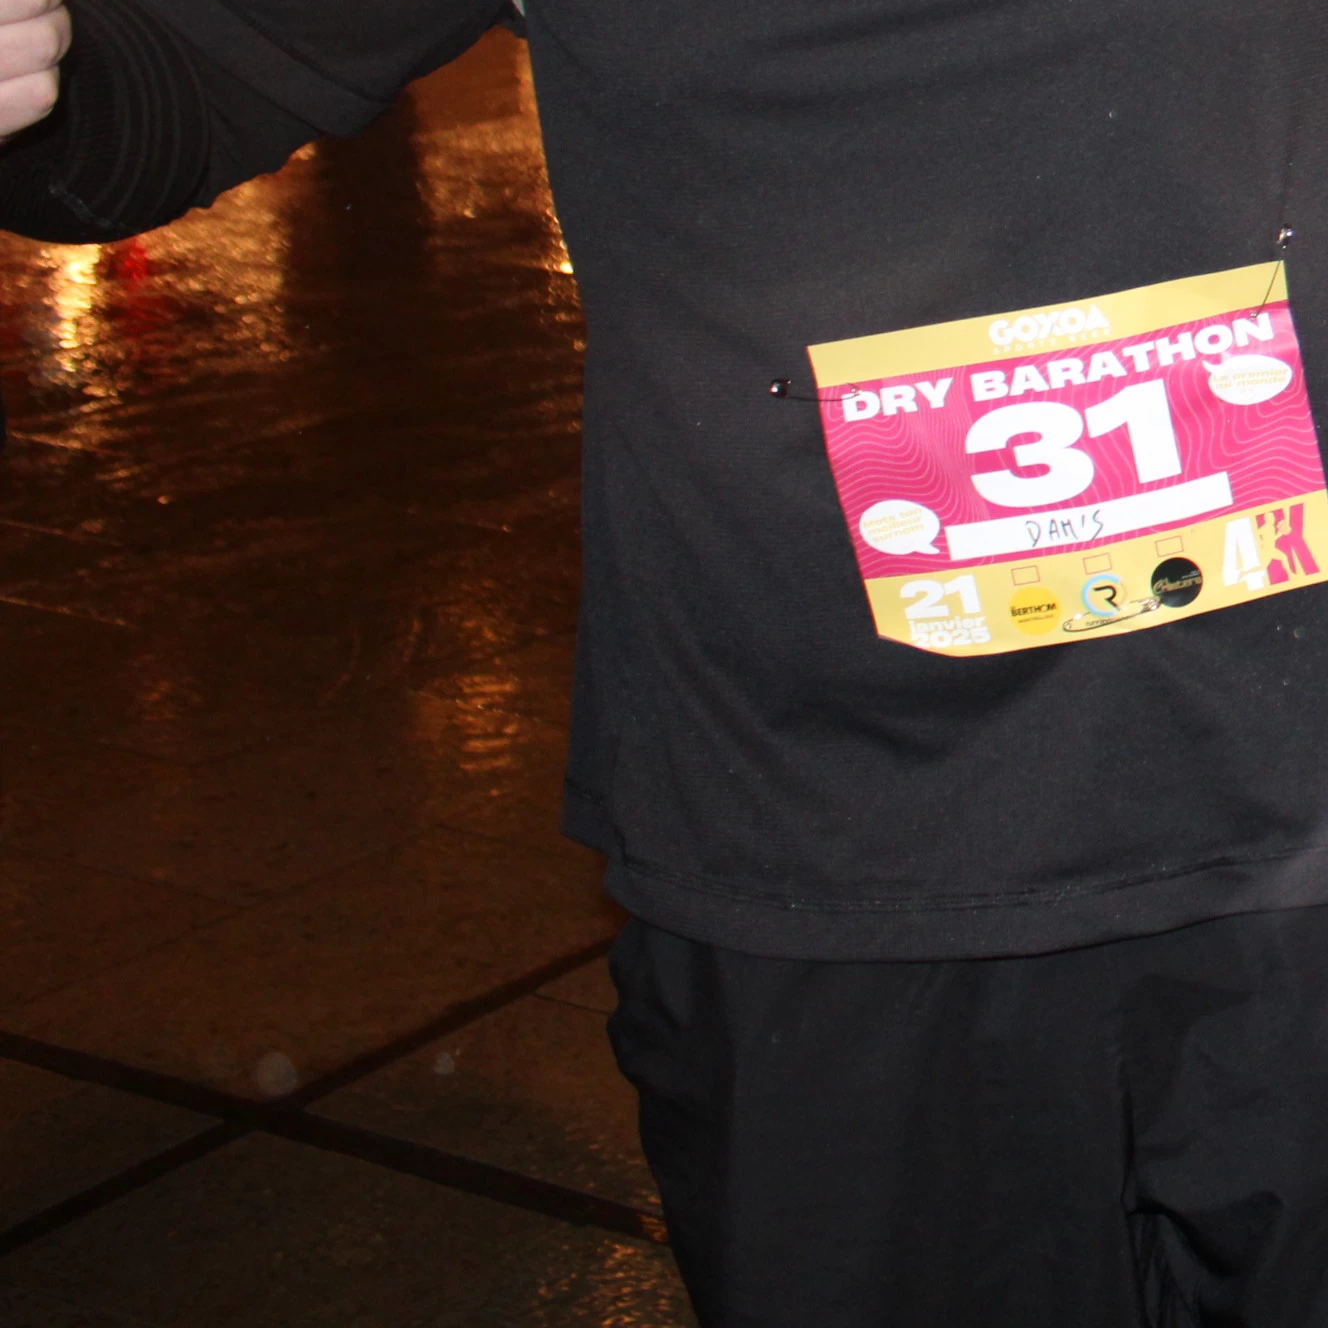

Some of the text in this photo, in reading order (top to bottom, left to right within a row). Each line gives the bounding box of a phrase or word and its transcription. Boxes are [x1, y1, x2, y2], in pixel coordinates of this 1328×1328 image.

[987, 303, 1110, 347] GOXOA
[842, 312, 1275, 422] DRY BARATHON
[965, 378, 1183, 508] 31
[1222, 502, 1321, 592] 4K
[900, 573, 982, 621] 21
[908, 615, 986, 640] janvier
[910, 625, 992, 649] 2025
